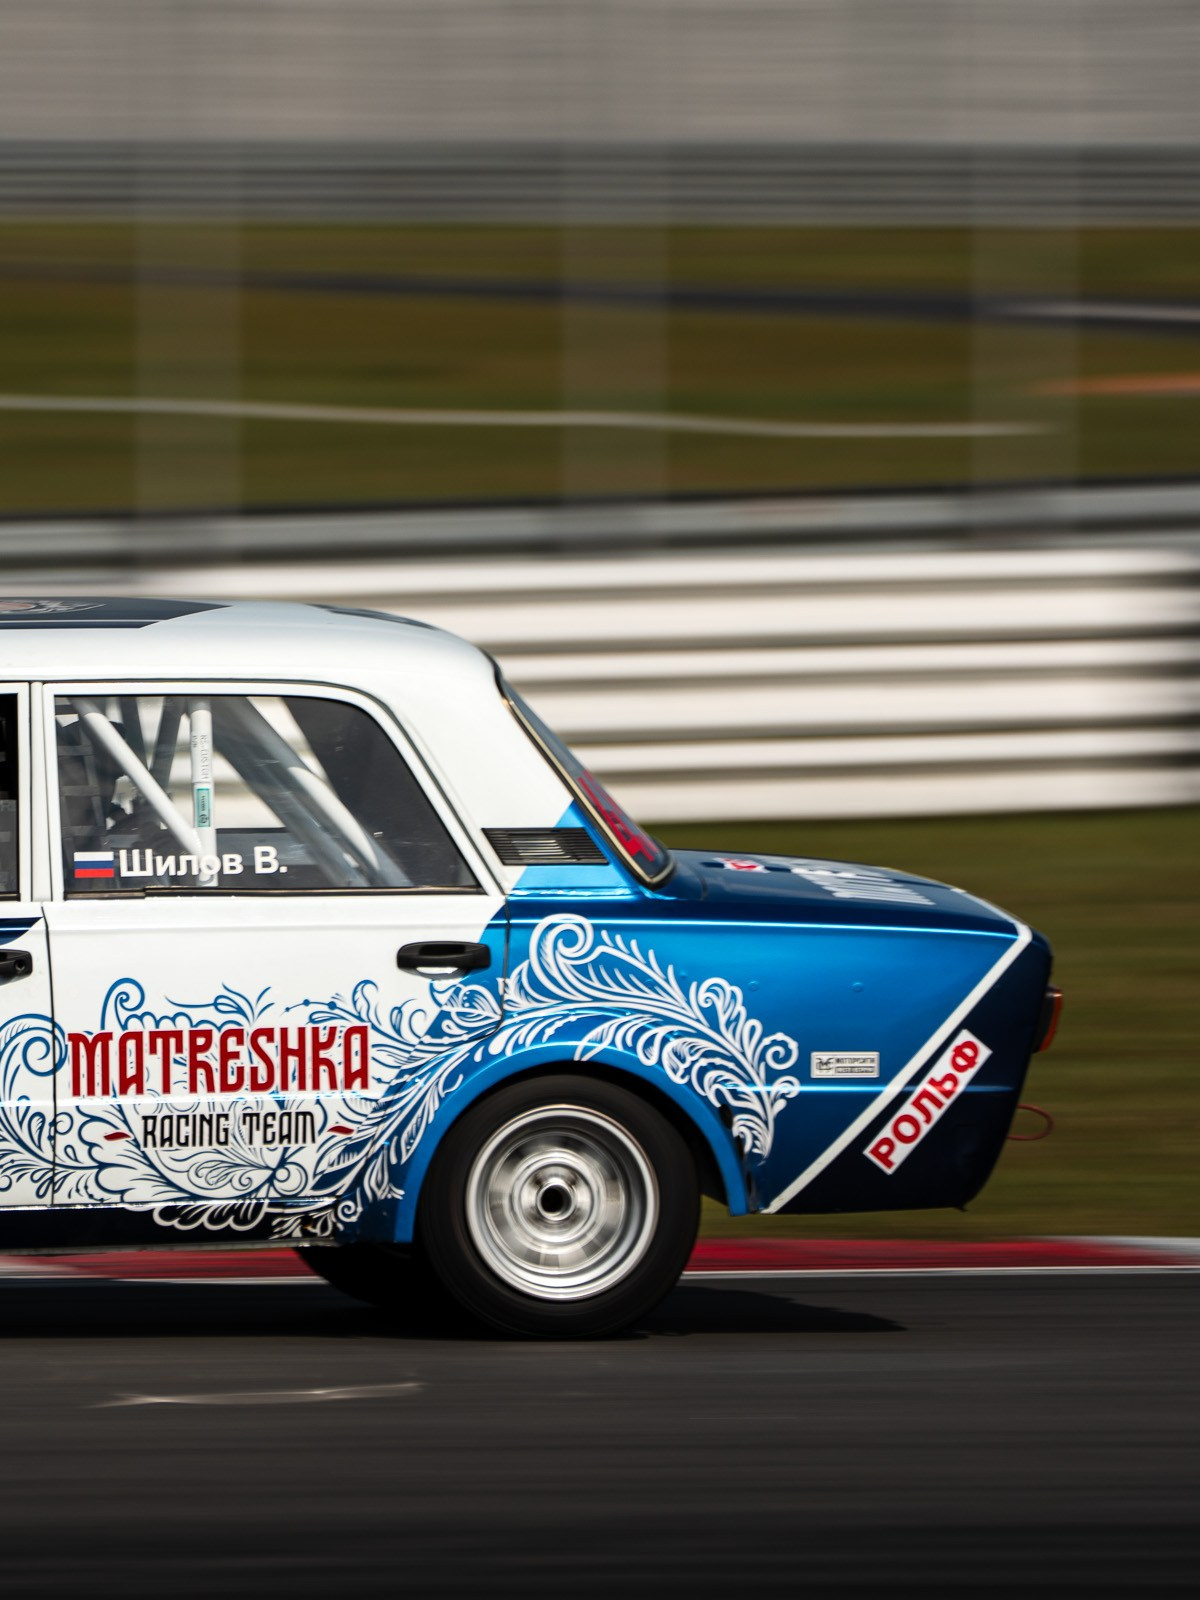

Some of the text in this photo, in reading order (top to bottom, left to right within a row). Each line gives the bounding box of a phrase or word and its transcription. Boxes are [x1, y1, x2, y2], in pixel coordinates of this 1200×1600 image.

[119, 845, 288, 877] Шилов В.
[67, 1025, 369, 1097] MATRESHKA
[141, 1110, 316, 1149] RACING TEAM
[869, 1040, 980, 1169] РОЛЬФ
